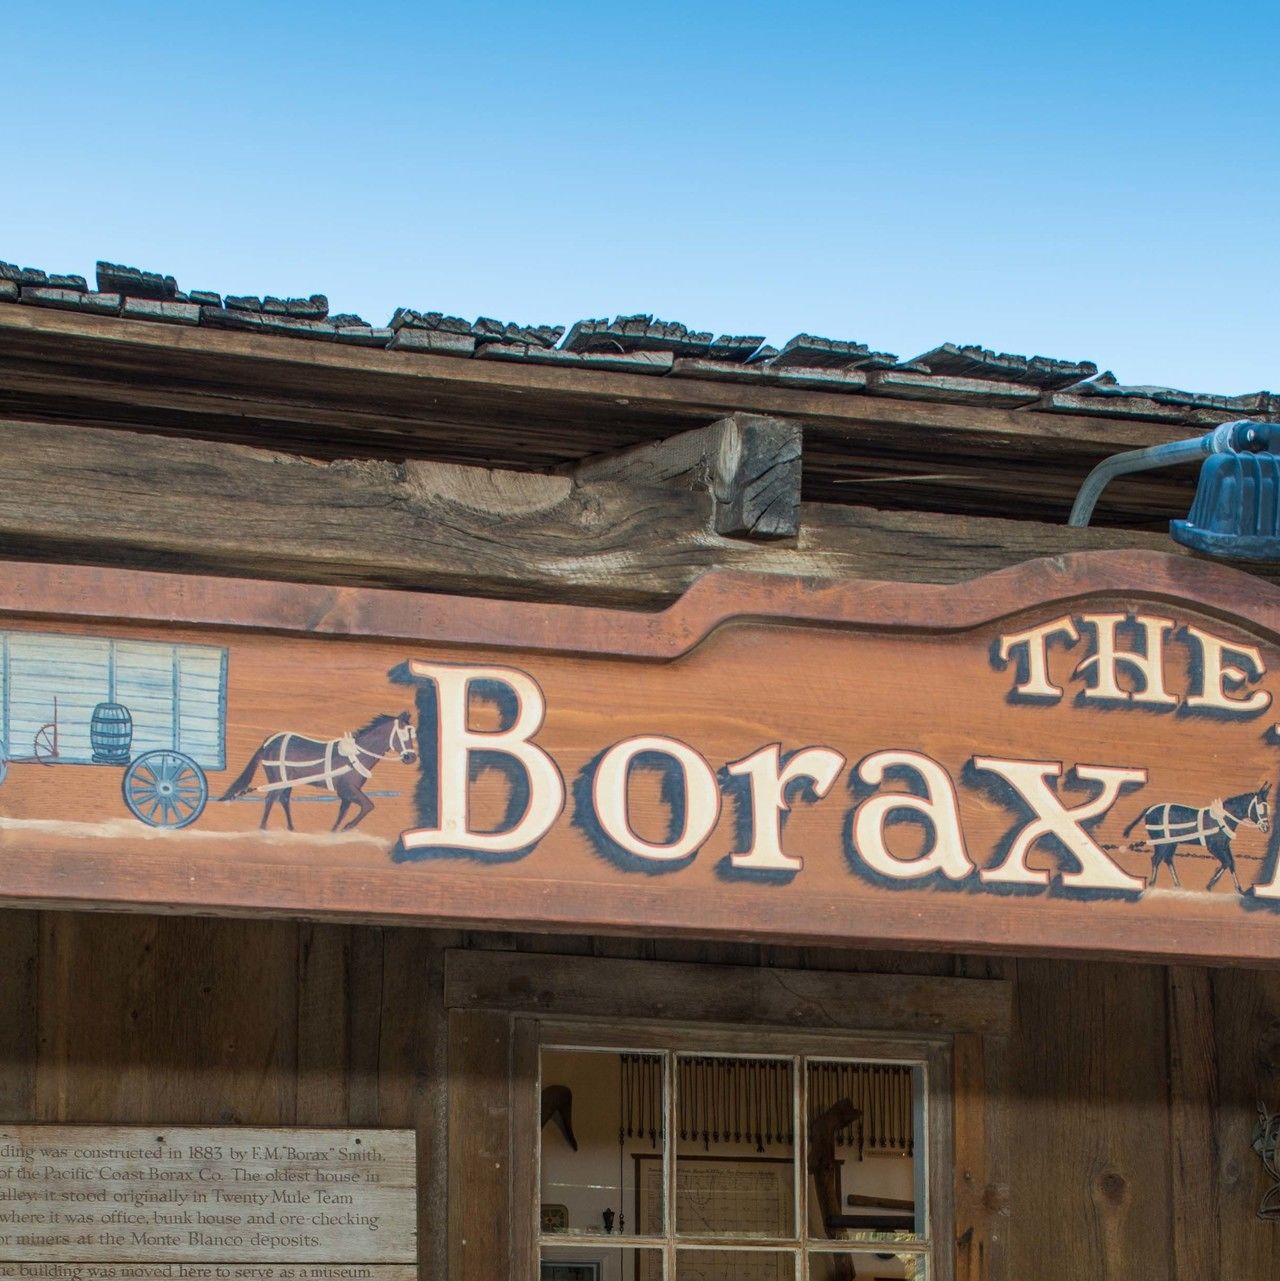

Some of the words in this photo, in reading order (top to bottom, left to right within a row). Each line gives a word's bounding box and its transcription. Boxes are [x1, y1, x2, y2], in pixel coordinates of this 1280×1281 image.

[997, 611, 1273, 712] THE
[398, 658, 1149, 894] Borax
[41, 1149, 68, 1158] was
[73, 1145, 162, 1159] constructed
[169, 1146, 182, 1160] in
[189, 1146, 223, 1160] 1883
[230, 1147, 248, 1162] by
[17, 1166, 40, 1180] the
[43, 1166, 93, 1180] Pacific
[99, 1166, 145, 1181] Coast
[149, 1167, 193, 1181] Borax
[198, 1168, 223, 1181] Co.
[231, 1168, 261, 1182] The
[265, 1168, 310, 1182] oldest
[316, 1169, 360, 1182] house
[366, 1170, 380, 1182] in
[44, 1189, 57, 1201] it
[61, 1189, 106, 1201] stood
[113, 1189, 189, 1208] originally
[193, 1190, 207, 1203] in
[211, 1189, 268, 1206] Twenty
[271, 1190, 310, 1204] Mule
[314, 1190, 353, 1204] Team
[49, 1211, 61, 1223] it
[64, 1214, 94, 1224] was
[153, 1211, 193, 1224] bunk
[197, 1212, 242, 1225] house
[246, 1212, 275, 1225] and
[279, 1213, 380, 1231] ore-checking
[16, 1233, 70, 1245] miners
[77, 1235, 94, 1245] at
[99, 1233, 125, 1245] the
[131, 1232, 181, 1246] Monte
[187, 1232, 243, 1247] Blanco
[250, 1233, 322, 1249] deposits.
[87, 1268, 116, 1278] was
[121, 1266, 171, 1278] moved
[178, 1265, 212, 1278] here
[216, 1267, 231, 1278] to
[234, 1268, 274, 1279] serve
[279, 1269, 295, 1279] as
[299, 1269, 308, 1279] a
[311, 1267, 375, 1279] museum.
